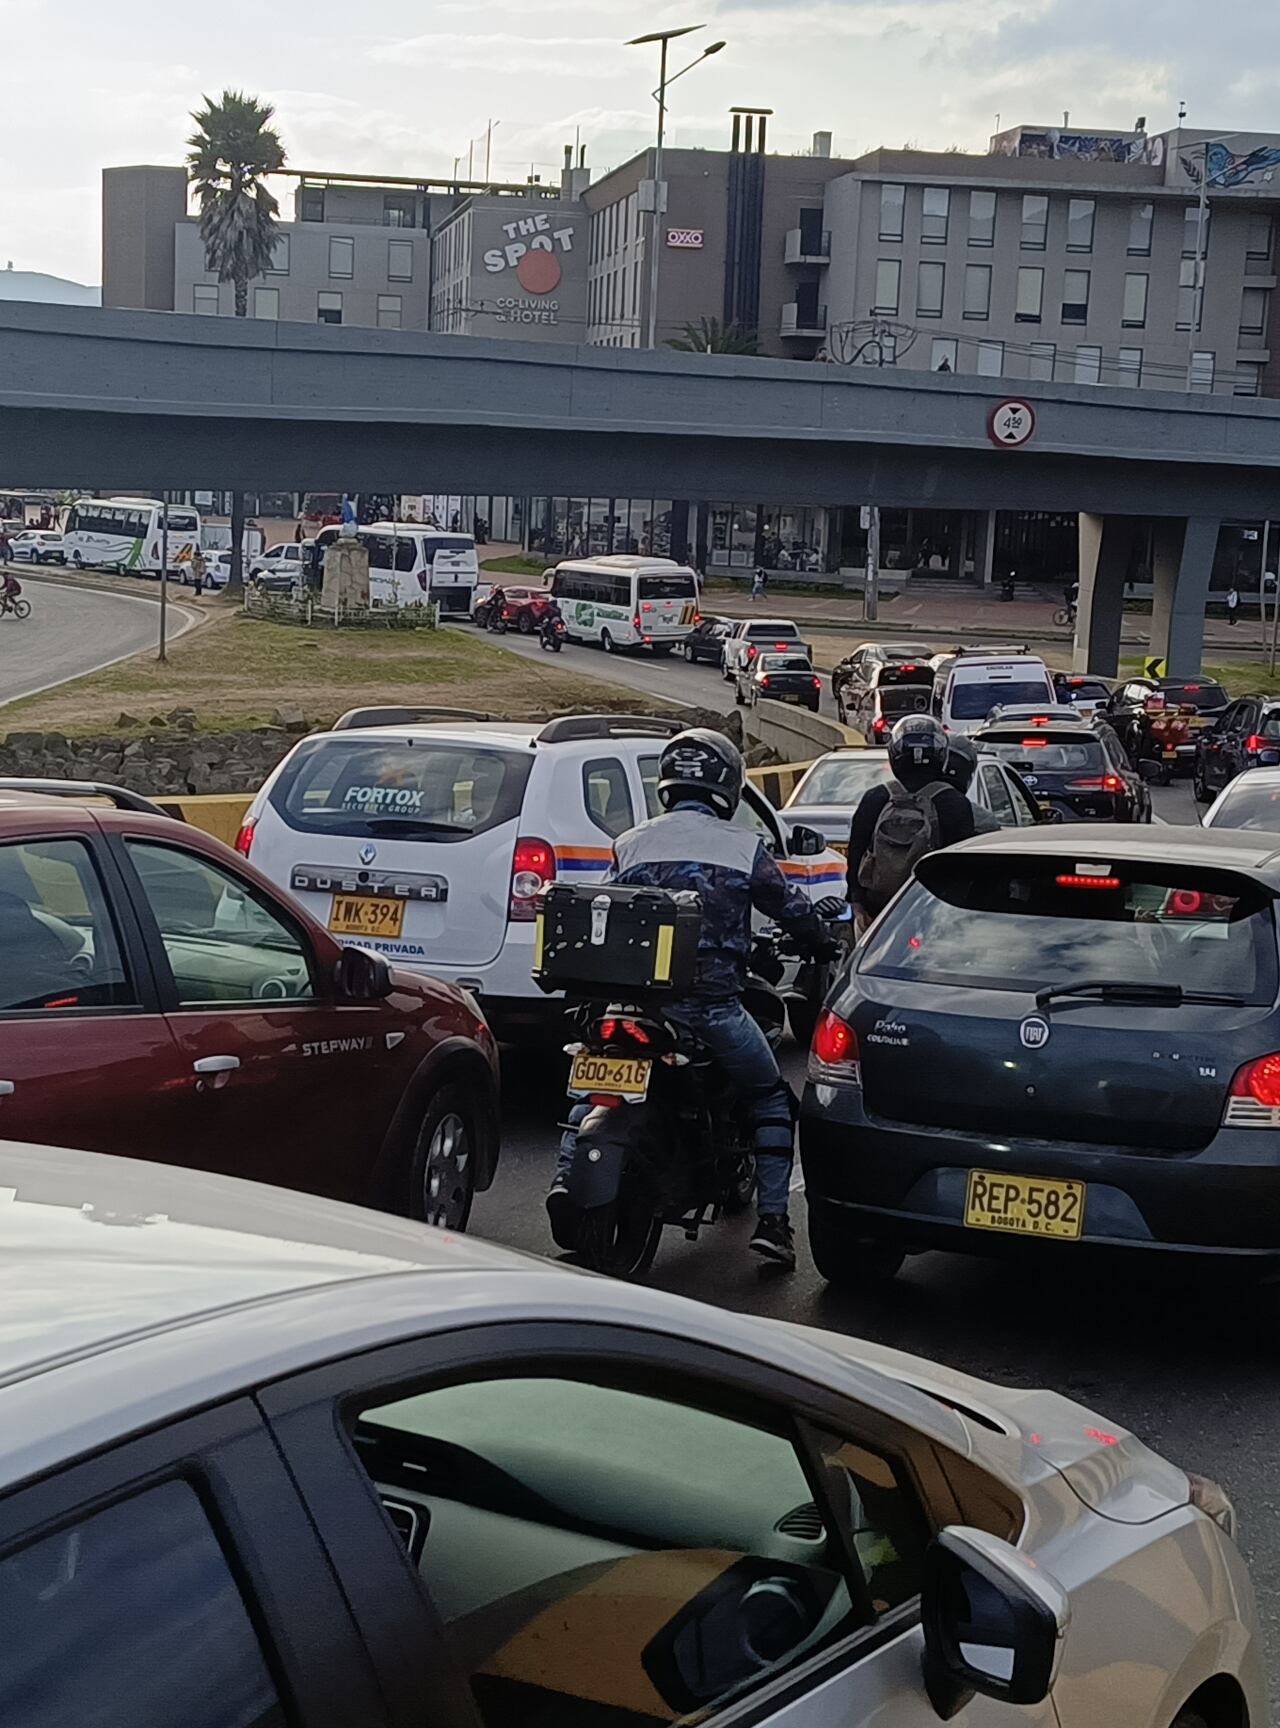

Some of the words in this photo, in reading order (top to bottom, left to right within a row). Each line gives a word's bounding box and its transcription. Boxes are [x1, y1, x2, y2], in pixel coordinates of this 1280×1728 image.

[502, 213, 551, 240] THE
[668, 231, 702, 244] OXXO
[483, 227, 575, 273] SPOT
[496, 298, 558, 310] CO-LIVING
[510, 309, 558, 325] HOTEL
[344, 786, 425, 806] FORTOX
[341, 802, 385, 813] SECURITY
[388, 805, 421, 814] GROUP
[294, 876, 437, 899] DUSTER
[375, 942, 425, 955] PRIVADA
[302, 1037, 365, 1056] STEPWAY
[991, 1215, 1026, 1228] BOGOTA
